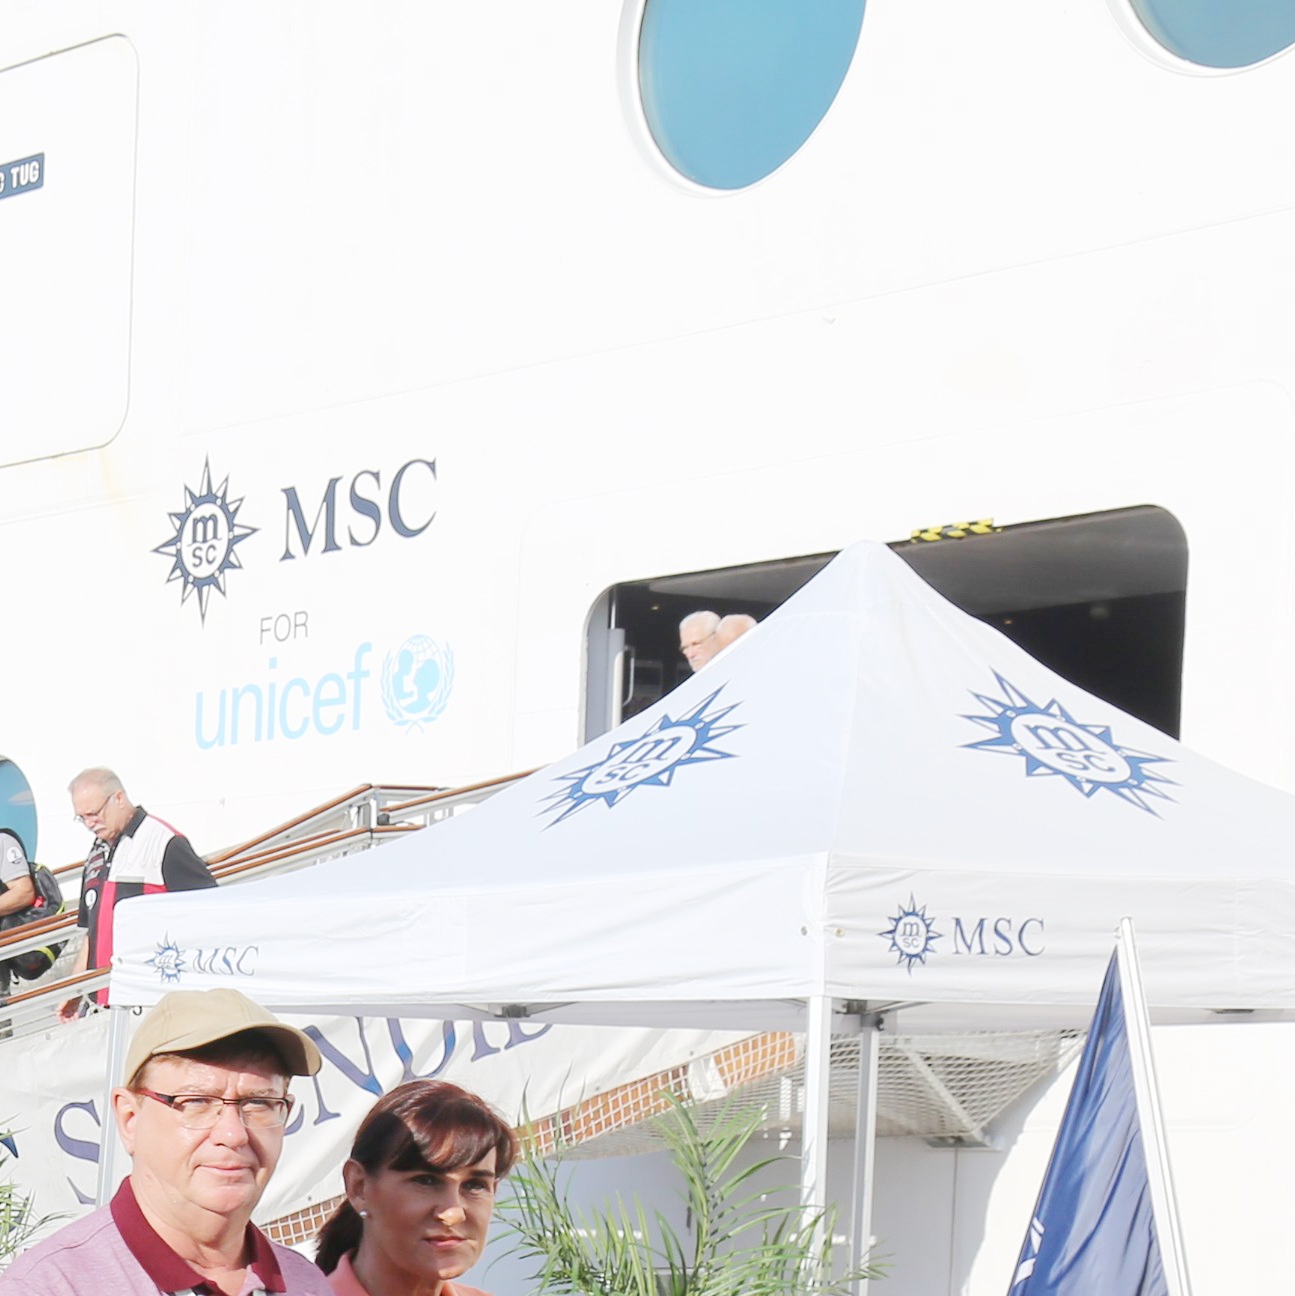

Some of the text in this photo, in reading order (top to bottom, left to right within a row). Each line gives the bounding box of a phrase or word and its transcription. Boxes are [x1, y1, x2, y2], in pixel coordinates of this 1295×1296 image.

[10, 160, 41, 189] TUG
[279, 456, 438, 562] MSC
[260, 610, 309, 645] FOR
[195, 641, 373, 750] unicef
[951, 917, 1046, 957] MSC
[192, 945, 259, 977] MSC
